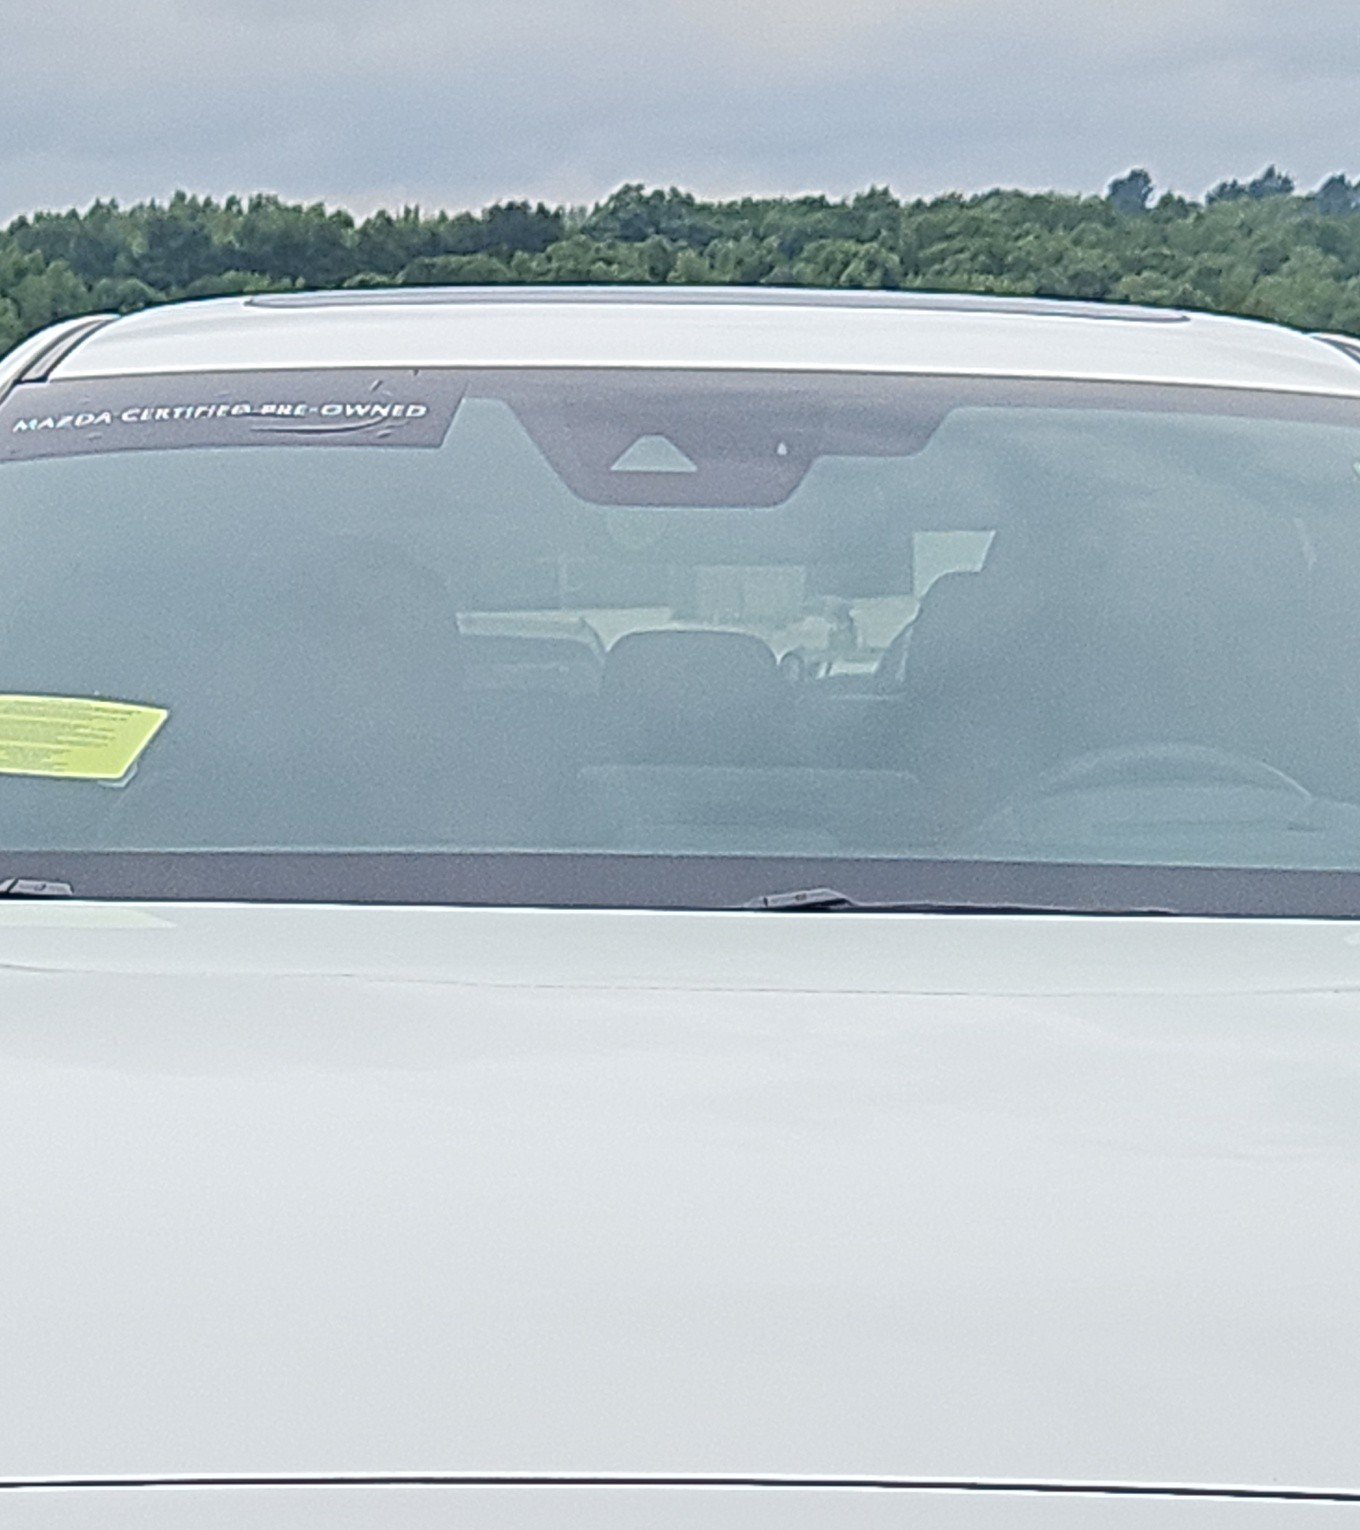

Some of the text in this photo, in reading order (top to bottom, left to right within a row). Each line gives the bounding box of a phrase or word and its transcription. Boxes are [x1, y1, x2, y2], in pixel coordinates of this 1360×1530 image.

[12, 403, 429, 432] MAZDA CERTIFIED PRE-OWNED
